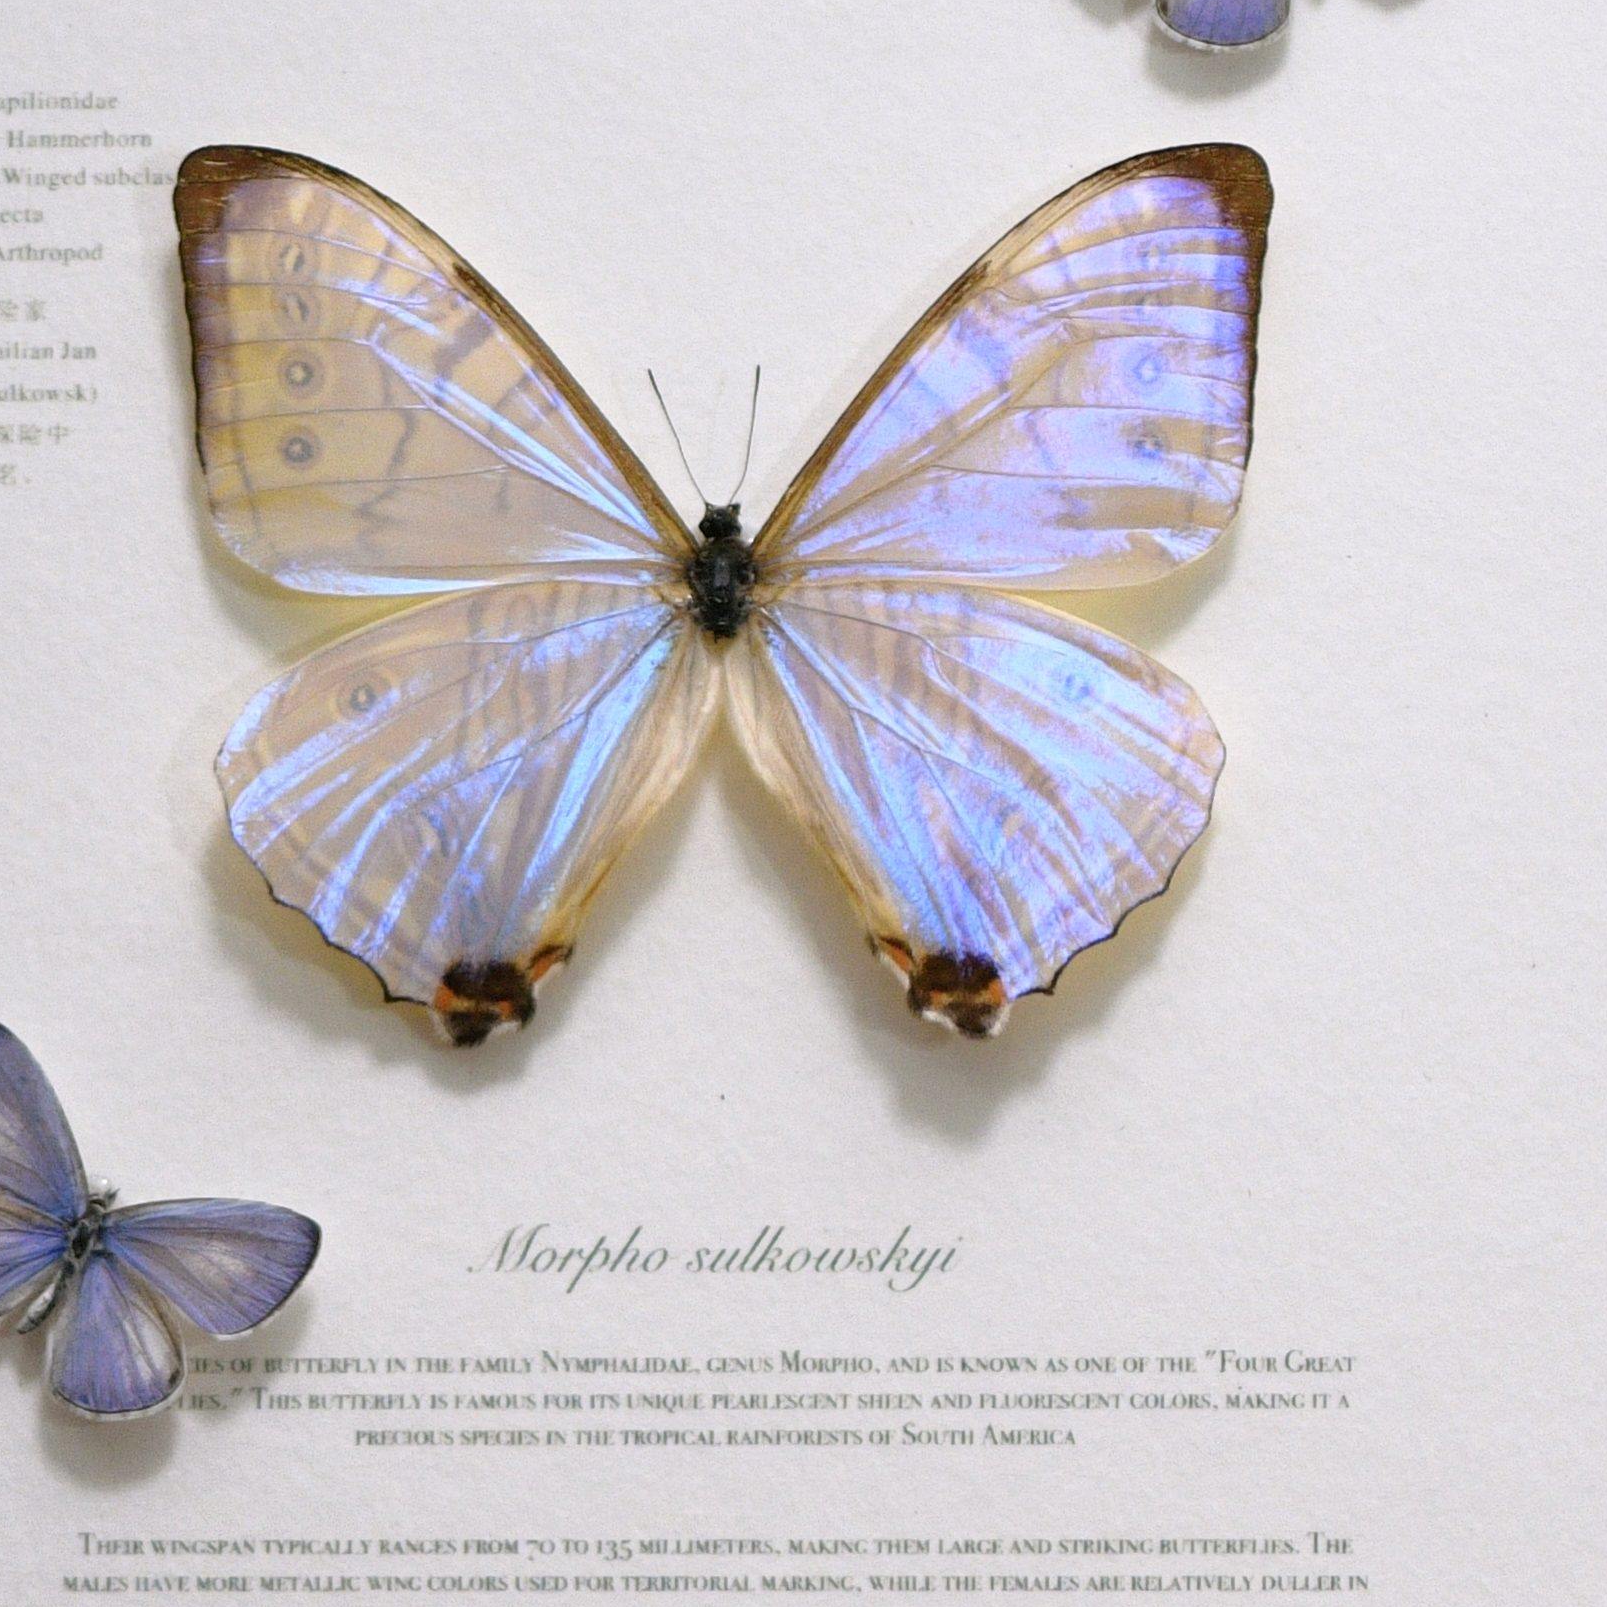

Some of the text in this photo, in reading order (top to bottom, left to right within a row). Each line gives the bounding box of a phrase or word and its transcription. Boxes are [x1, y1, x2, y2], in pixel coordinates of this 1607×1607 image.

[92, 167, 179, 186] subclas
[60, 342, 98, 360] Jan
[467, 1223, 964, 1293] Morpho sulkowskyi
[263, 1356, 378, 1373] BUTTERFLY
[458, 1356, 533, 1373] FAMILY
[705, 1356, 774, 1373] GENUS
[958, 1356, 1038, 1373] KNOWN
[1073, 1356, 1117, 1373] ONE
[1282, 1350, 1354, 1373] GREAT
[252, 1387, 302, 1409] THIS
[306, 1393, 422, 1409] BUTTERFLY
[453, 1393, 537, 1409] FAMOUS
[625, 1393, 703, 1413] UNIQUE
[710, 1393, 849, 1409] PEARLESCENT
[856, 1393, 923, 1409] SHEEN
[978, 1393, 1122, 1409] FLUORESCENT
[1224, 1393, 1305, 1409] MAKING
[353, 1422, 1076, 1445] PRECIOUS SPECIES THE TROPICAL RAINFORESTS SOUTH AMERICA
[79, 1532, 145, 1555] THEIR
[150, 1538, 256, 1555] WINGSPAN
[262, 1538, 371, 1555] TYPICALLY
[377, 1538, 457, 1555] RANGES
[461, 1538, 520, 1555] FROM
[527, 1538, 556, 1560] 70
[595, 1538, 633, 1560] 135
[787, 1538, 867, 1555] MAKING
[874, 1538, 931, 1555] THEM
[937, 1538, 1004, 1555] LARGE
[1057, 1538, 1154, 1555] STRIKING
[61, 1575, 129, 1592] MALES
[133, 1575, 190, 1592] HAVE
[195, 1575, 252, 1592] MORE
[258, 1575, 359, 1592] METALLIC
[367, 1575, 422, 1592] WING
[426, 1575, 509, 1592] COLORS
[513, 1575, 569, 1592] USED
[622, 1575, 756, 1592] TERRITORIAL
[868, 1575, 936, 1592] WHILE
[988, 1575, 1080, 1592] FEMALES
[1129, 1575, 1252, 1592] RELATIVELY
[1260, 1575, 1342, 1592] DULLER
